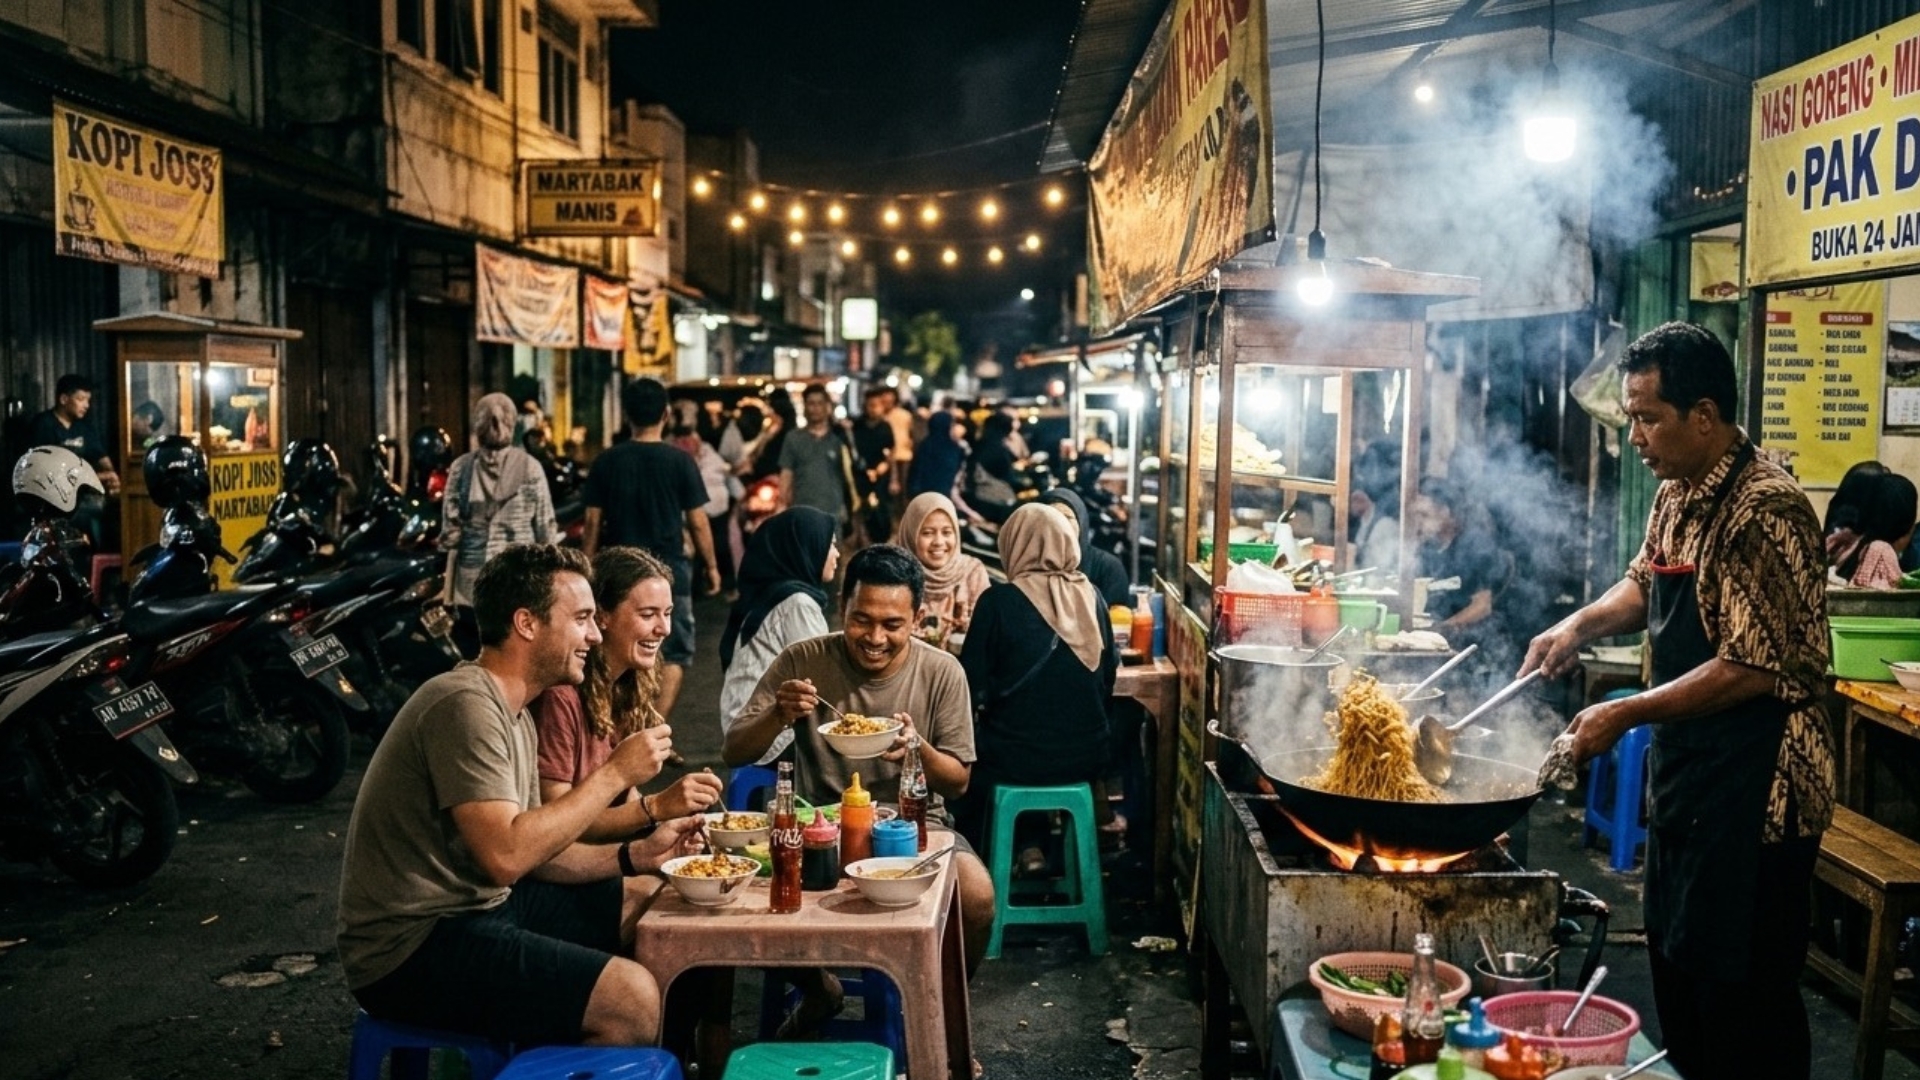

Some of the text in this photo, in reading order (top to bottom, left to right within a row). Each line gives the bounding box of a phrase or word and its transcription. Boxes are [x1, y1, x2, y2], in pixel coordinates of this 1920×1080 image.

[1761, 36, 1920, 141] NASI GORENG MI
[67, 113, 214, 194] KOPI JOSS
[1803, 117, 1920, 210] PAK D
[537, 172, 644, 192] MARTABAK
[557, 203, 617, 222] MANIS
[1811, 211, 1920, 261] BUKA 24 JA
[213, 460, 276, 493] KOPI JOSS
